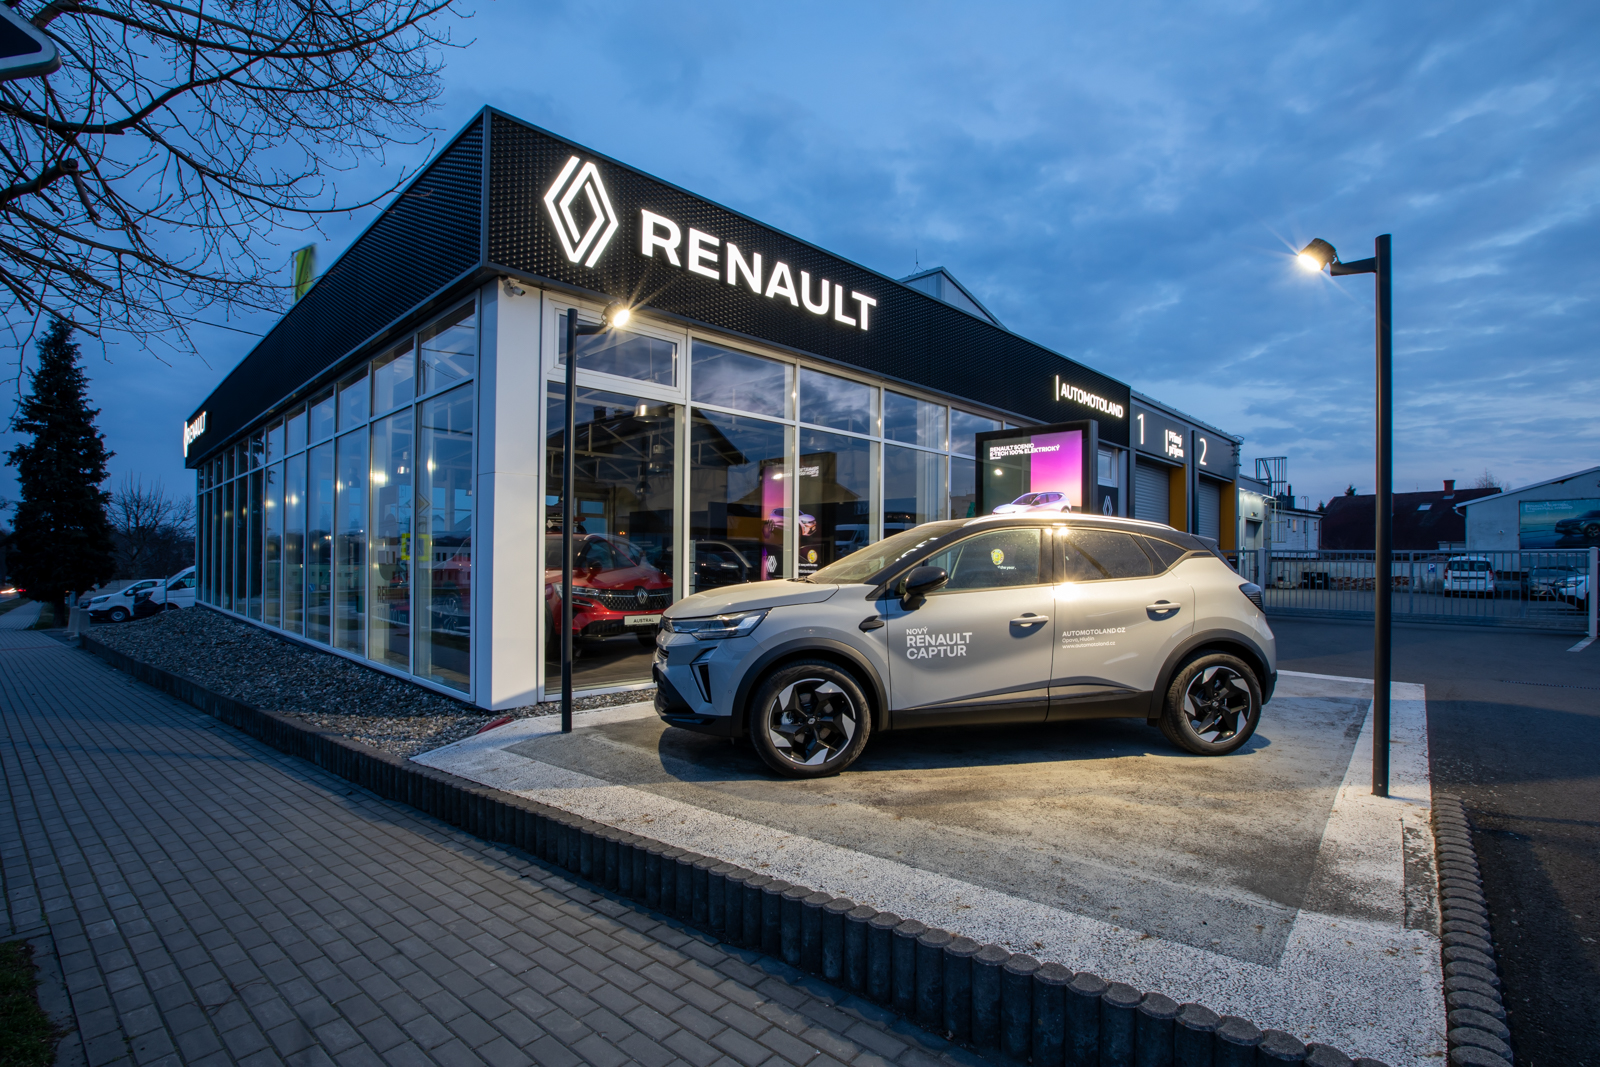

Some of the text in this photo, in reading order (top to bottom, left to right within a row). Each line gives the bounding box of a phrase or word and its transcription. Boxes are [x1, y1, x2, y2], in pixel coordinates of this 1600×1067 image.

[641, 208, 877, 331] RENAULT
[1060, 383, 1124, 419] AUTOMOTOLAND
[1137, 413, 1145, 445] 1
[990, 445, 1013, 453] RENAULT
[1199, 437, 1207, 466] 2
[1428, 563, 1436, 571] P
[906, 626, 928, 635] NOVÝ
[906, 632, 973, 647] RENAULT
[1062, 640, 1116, 649] www.automotoland.cz
[906, 645, 967, 660] CAPTUR
